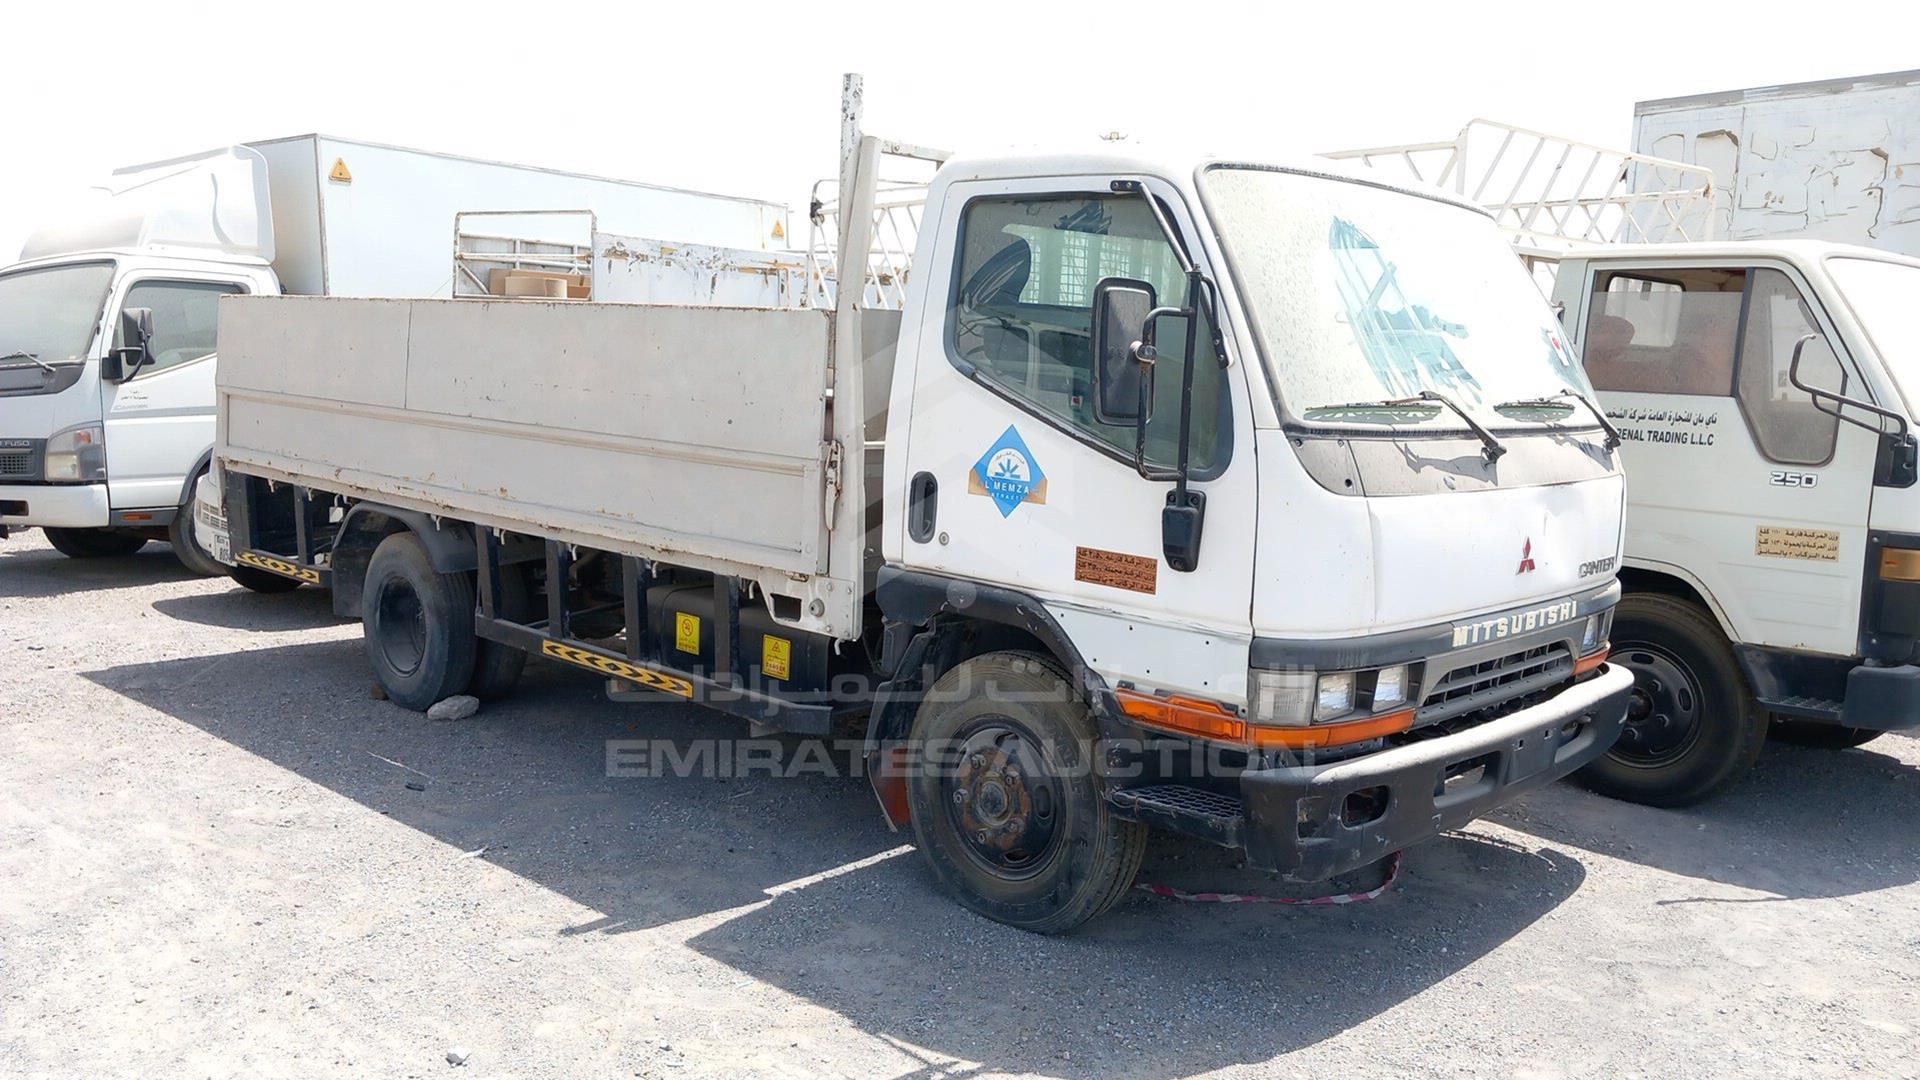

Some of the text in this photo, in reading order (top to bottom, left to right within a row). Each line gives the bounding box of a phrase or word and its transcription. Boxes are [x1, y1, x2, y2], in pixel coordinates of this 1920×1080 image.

[1647, 429, 1688, 445] TRADING
[1690, 432, 1715, 446] L.L.C
[994, 480, 1033, 495] MEMZA
[1769, 470, 1819, 489] 250
[1578, 556, 1616, 578] CANTER
[1452, 600, 1578, 648] MITSUBISHI
